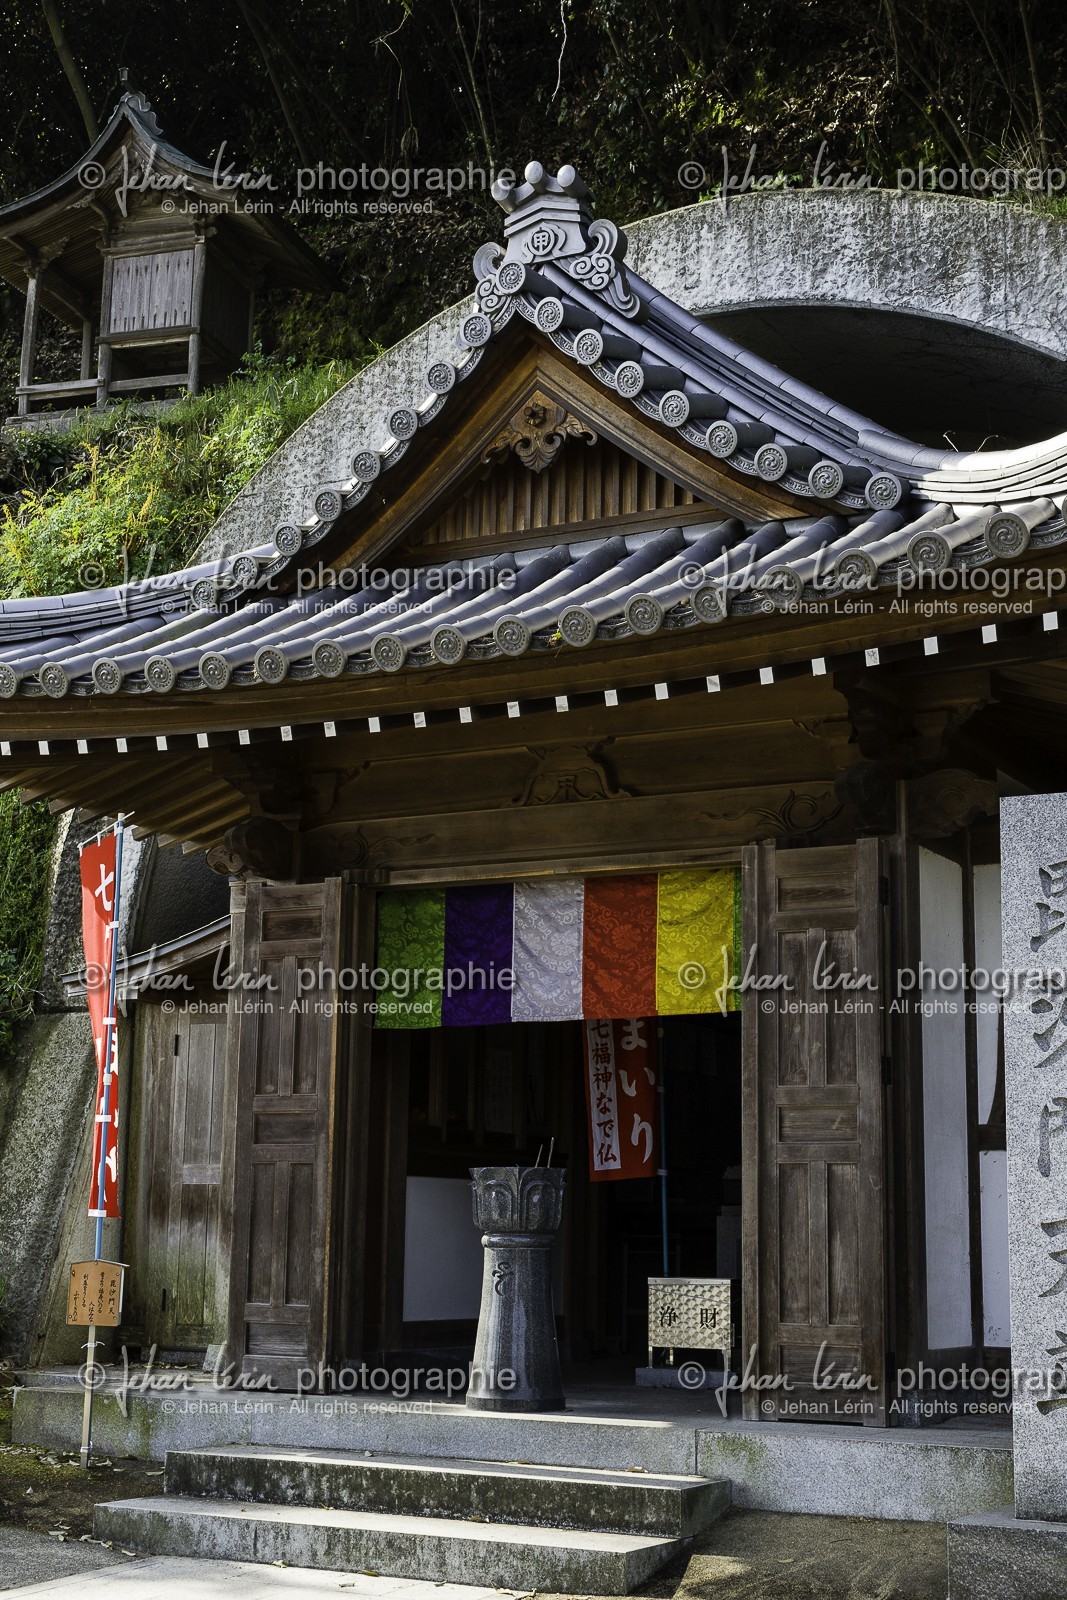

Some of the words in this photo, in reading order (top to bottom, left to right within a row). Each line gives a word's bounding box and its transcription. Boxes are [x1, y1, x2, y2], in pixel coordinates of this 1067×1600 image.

[591, 1022, 617, 1166] 七福神なで仏
[619, 1018, 655, 1164] まいり
[108, 1280, 117, 1315] 毘沙門天
